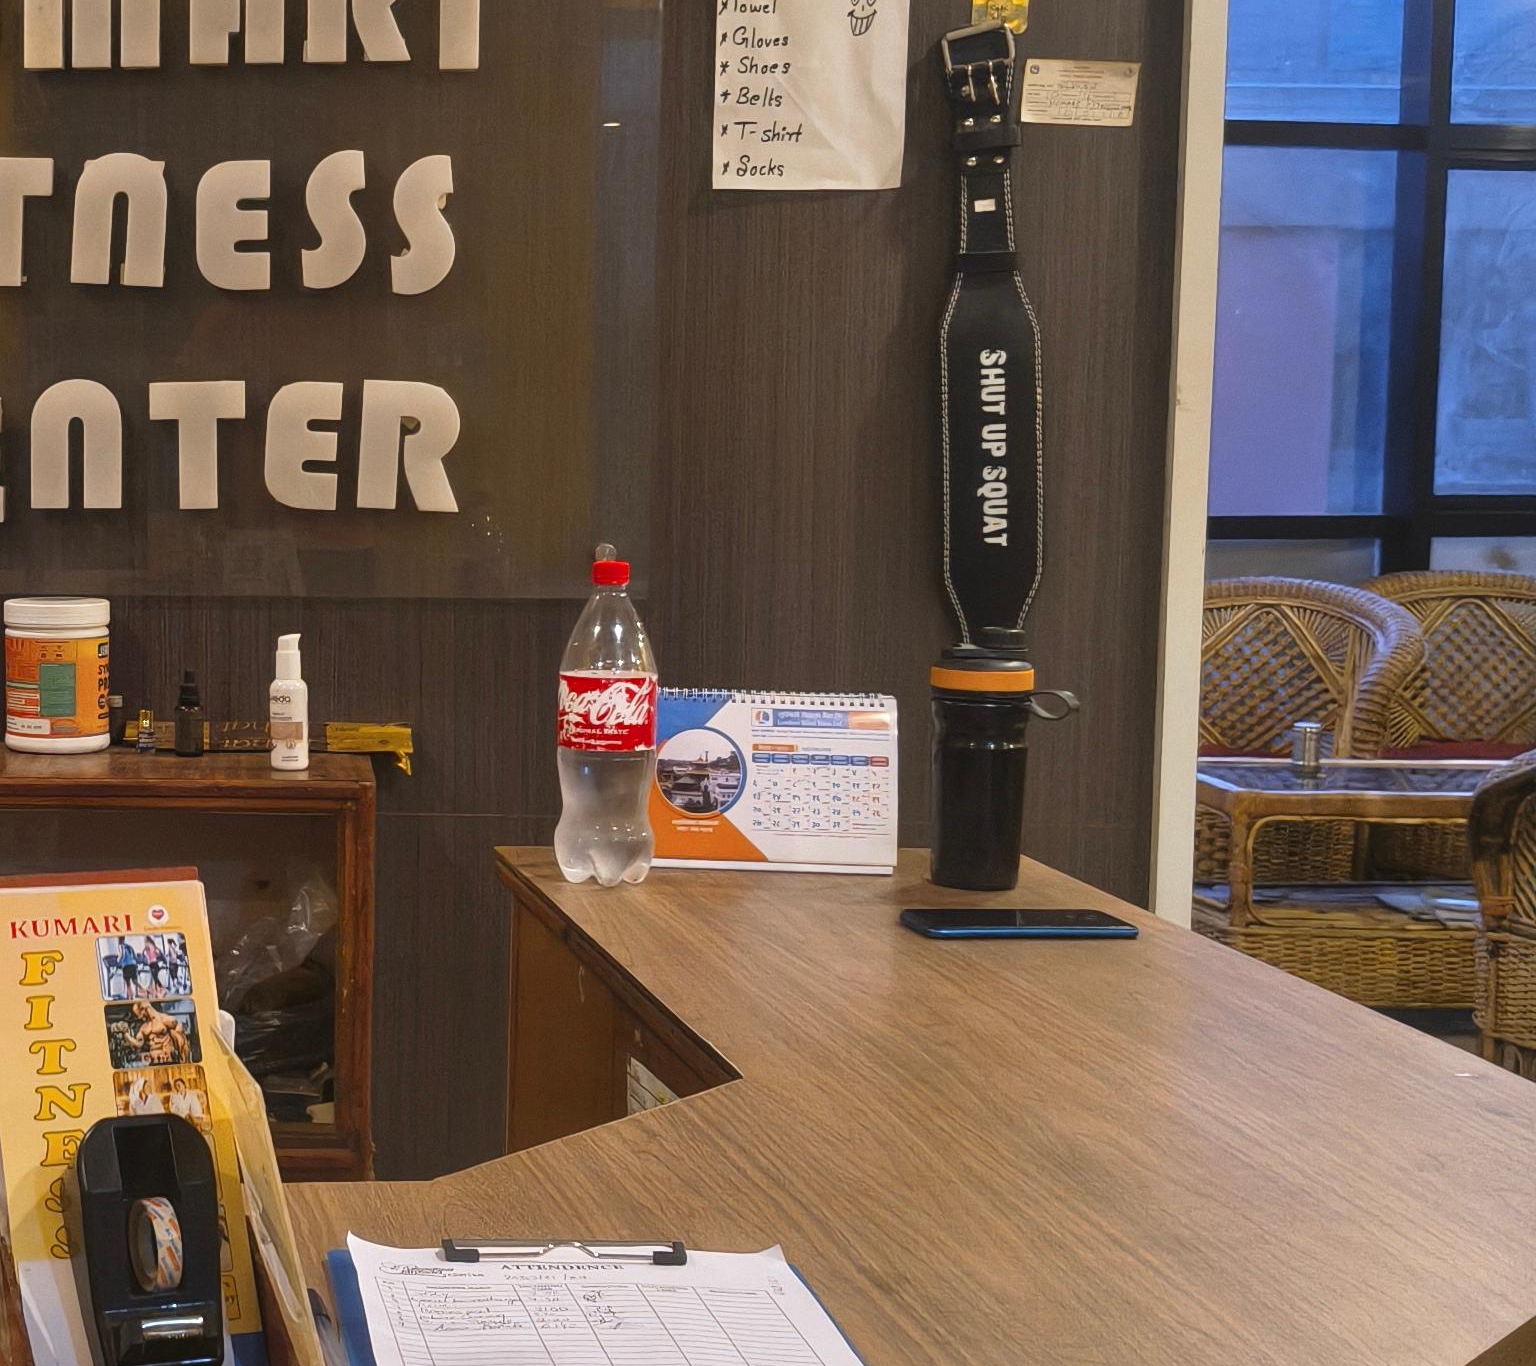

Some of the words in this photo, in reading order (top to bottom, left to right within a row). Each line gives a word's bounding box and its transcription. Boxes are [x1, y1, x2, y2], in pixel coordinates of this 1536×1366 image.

[732, 26, 789, 49] Gloves
[737, 56, 791, 75] Shoes
[736, 86, 783, 107] Belts
[736, 154, 785, 177] Socks
[979, 347, 1007, 415] SHUT
[980, 422, 1007, 458] UP
[976, 465, 1008, 547] SQUAT
[9, 914, 134, 939] KUMARI
